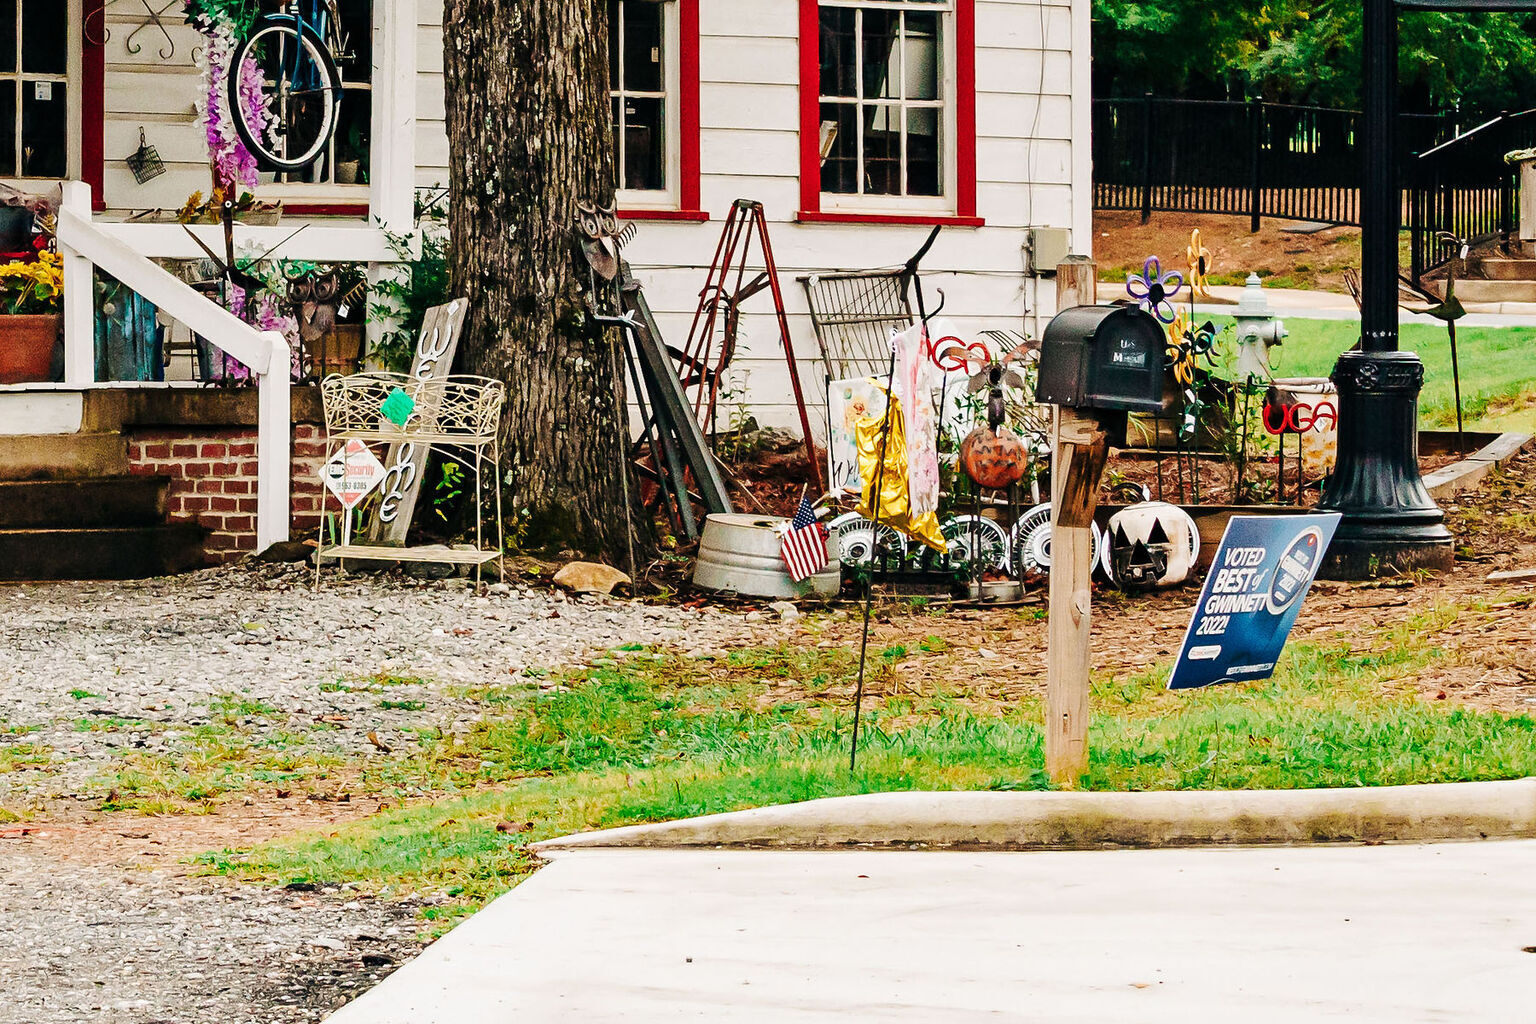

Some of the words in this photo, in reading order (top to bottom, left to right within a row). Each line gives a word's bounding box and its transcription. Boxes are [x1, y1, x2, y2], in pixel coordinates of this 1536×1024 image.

[1262, 402, 1337, 435] UGA
[1224, 547, 1267, 567] VOTED
[1212, 568, 1258, 594] BEST
[1251, 568, 1269, 592] of
[1205, 593, 1269, 615] GWINNETT
[1196, 615, 1231, 636] 2022!
